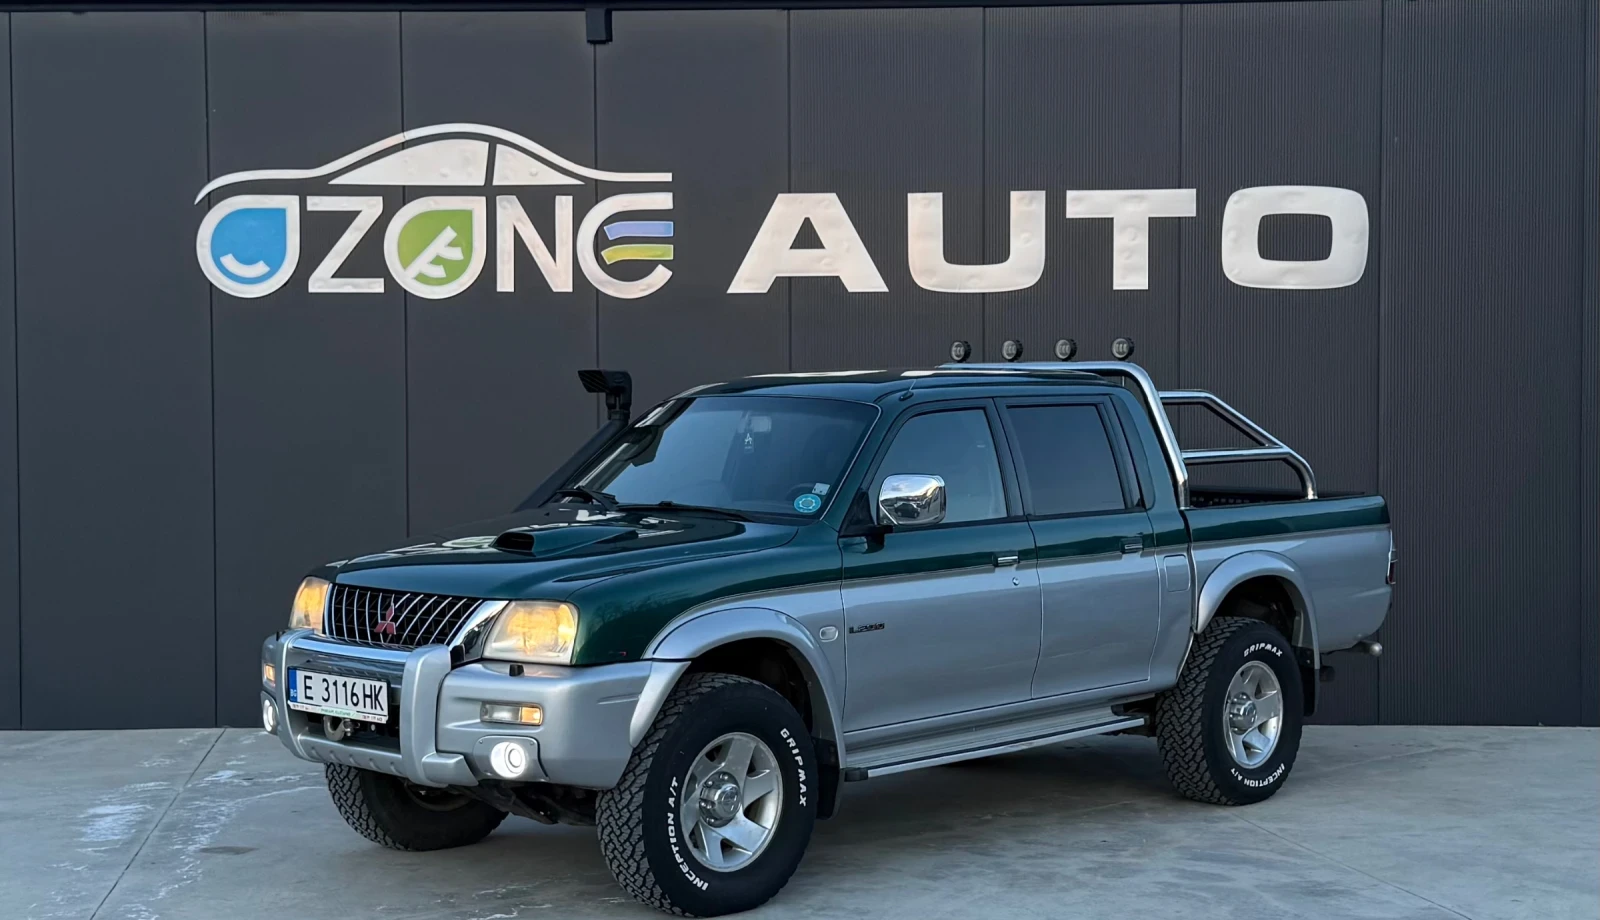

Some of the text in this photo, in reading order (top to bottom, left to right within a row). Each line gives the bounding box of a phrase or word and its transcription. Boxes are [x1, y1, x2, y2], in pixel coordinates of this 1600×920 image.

[196, 185, 1369, 299] OZONE AUTO
[1243, 643, 1282, 657] GRIPMAX
[304, 675, 384, 711] E 3116 HK
[780, 728, 806, 806] GRIPMAX
[1245, 763, 1285, 787] INCEPTION
[668, 776, 709, 891] INCEPTION A/T
